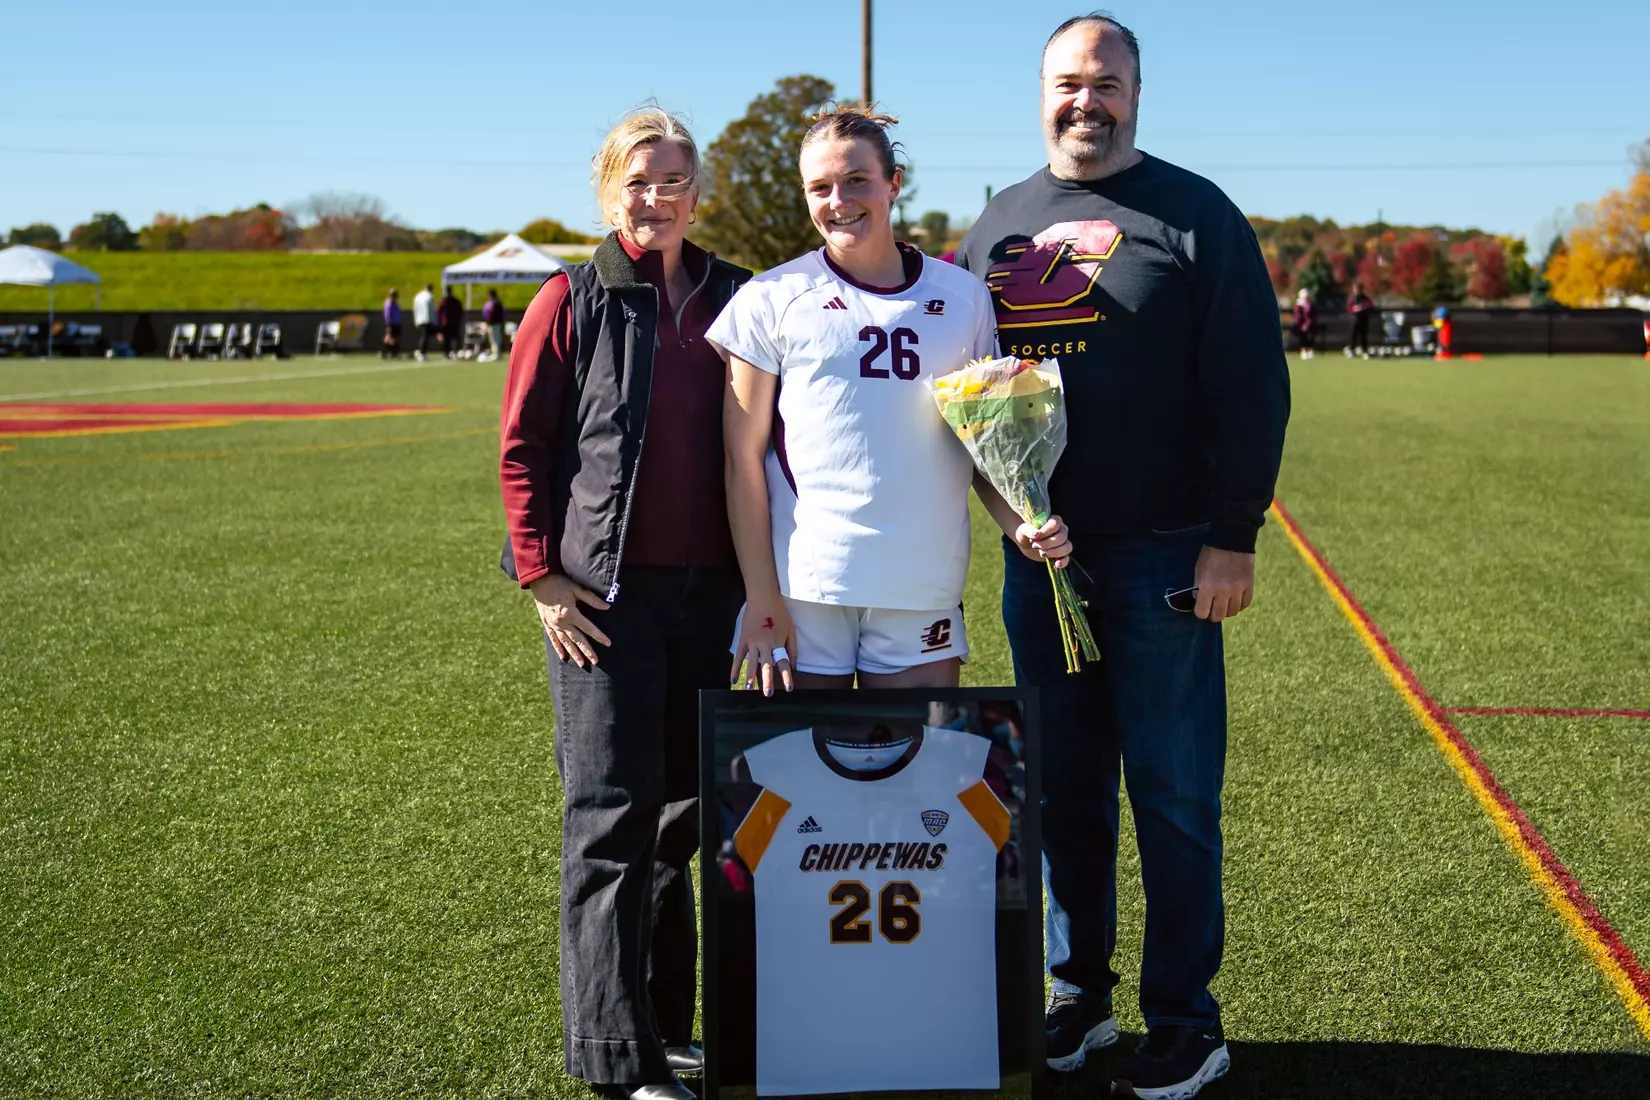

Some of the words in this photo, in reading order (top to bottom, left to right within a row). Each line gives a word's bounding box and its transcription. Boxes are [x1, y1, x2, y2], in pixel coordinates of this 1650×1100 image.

[859, 325, 920, 380] 26
[1010, 341, 1087, 356] SOCCER
[799, 842, 948, 872] CHIPPEWAS
[828, 880, 921, 944] 26
